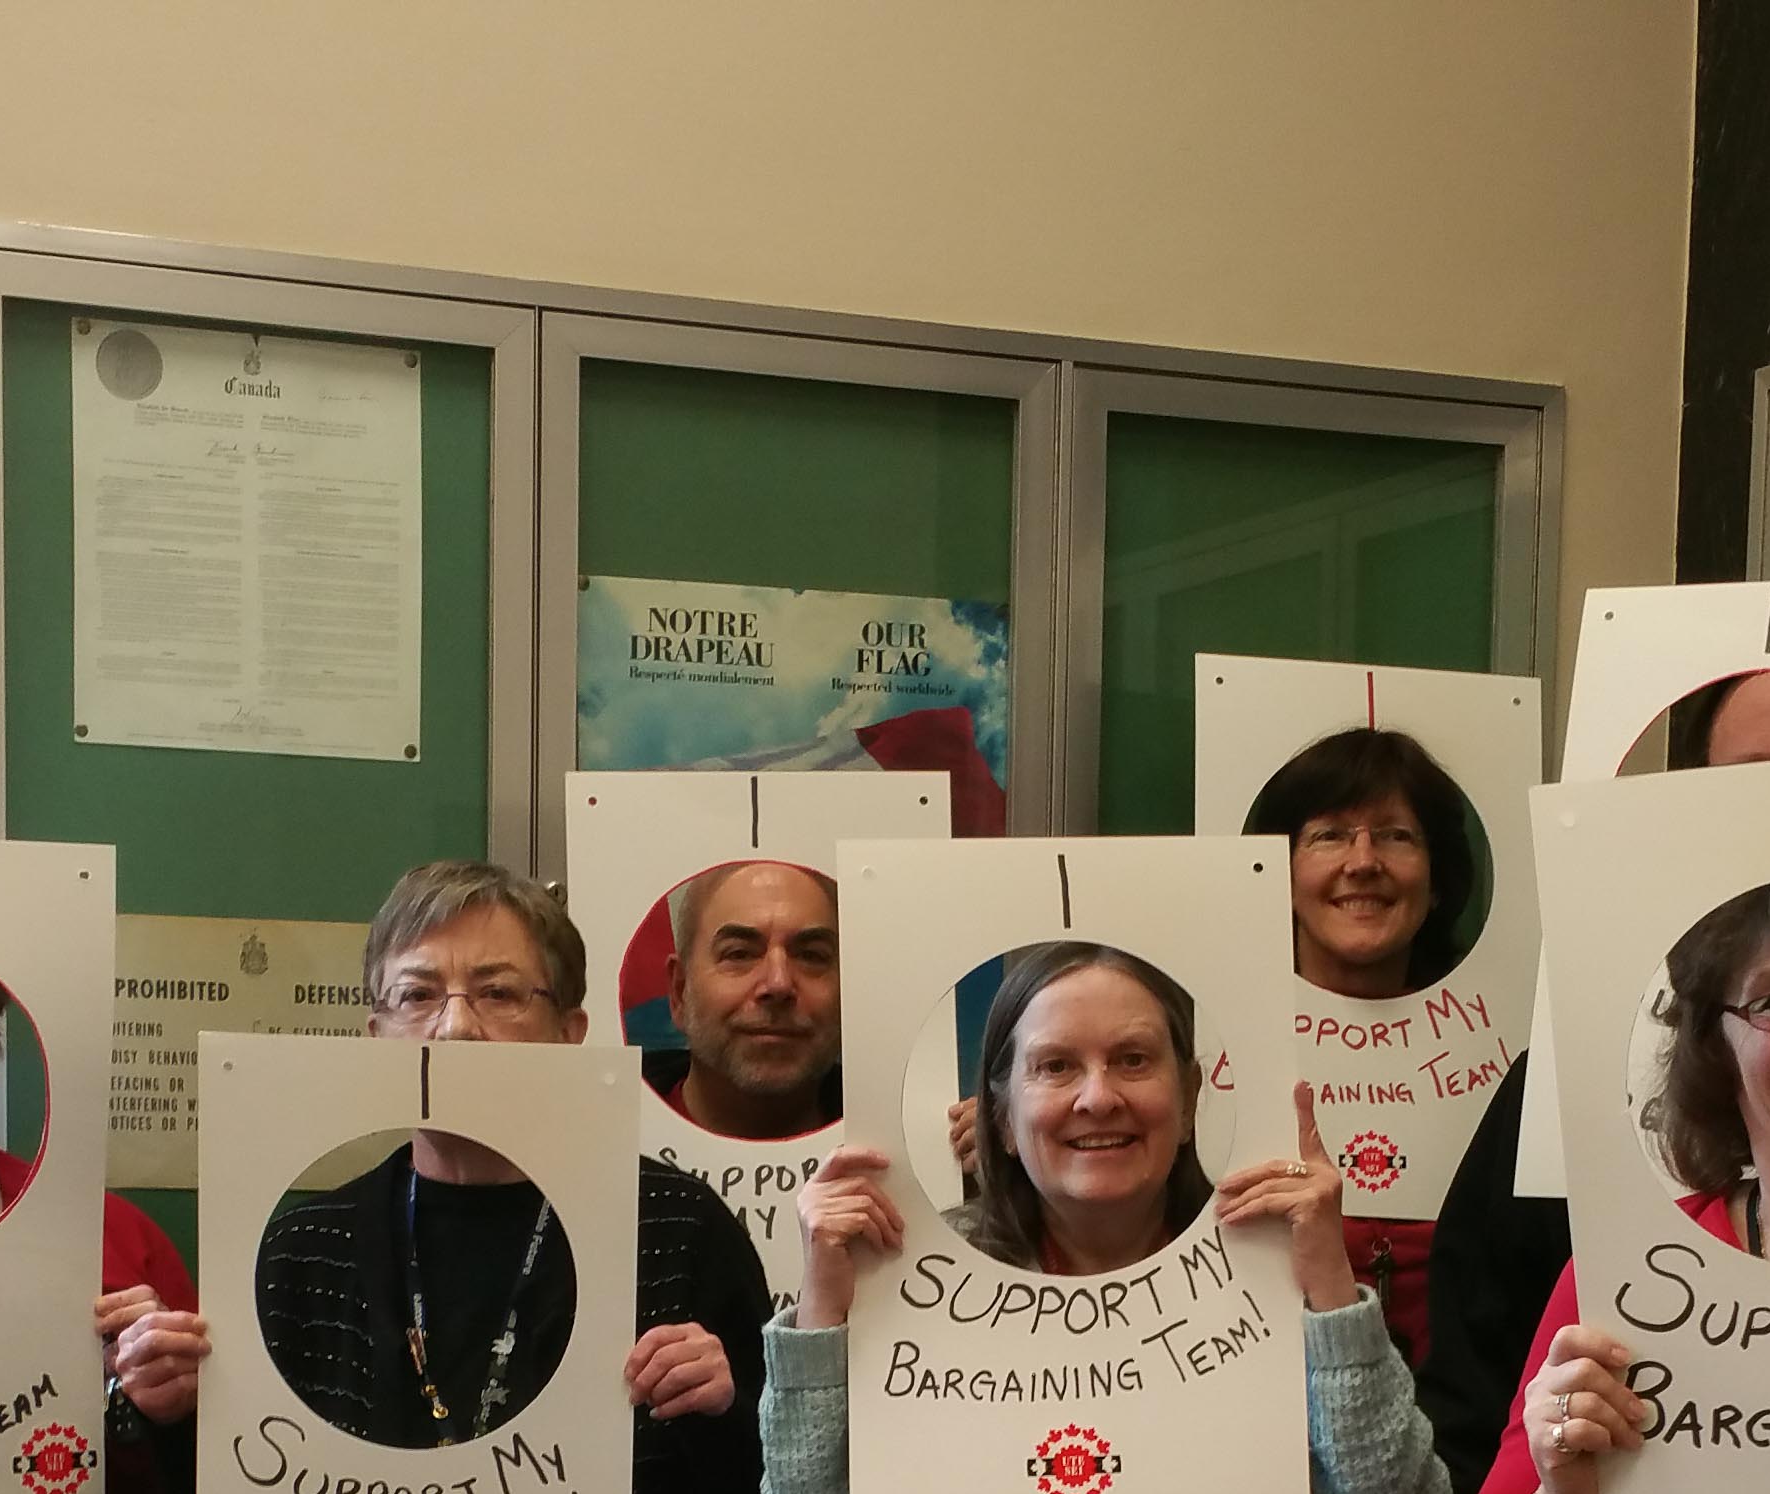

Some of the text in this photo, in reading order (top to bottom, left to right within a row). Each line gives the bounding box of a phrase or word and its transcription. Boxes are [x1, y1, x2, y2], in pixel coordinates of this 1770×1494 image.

[224, 376, 281, 399] Canada
[647, 606, 759, 638] NOTRE
[861, 621, 927, 649] OUR
[629, 634, 776, 668] DRAPEAU
[854, 648, 931, 677] FLAG
[688, 670, 775, 687] mondialement
[831, 677, 892, 695] Respected
[114, 977, 230, 1002] PROHIBITED
[170, 1077, 184, 1092] OR
[162, 1116, 176, 1131] OR
[900, 1254, 1163, 1335] SUPPORT
[884, 1290, 1271, 1402] BARGAINING TEAM!
[1061, 1454, 1086, 1467] UTE
[1064, 1465, 1084, 1476] SEI
